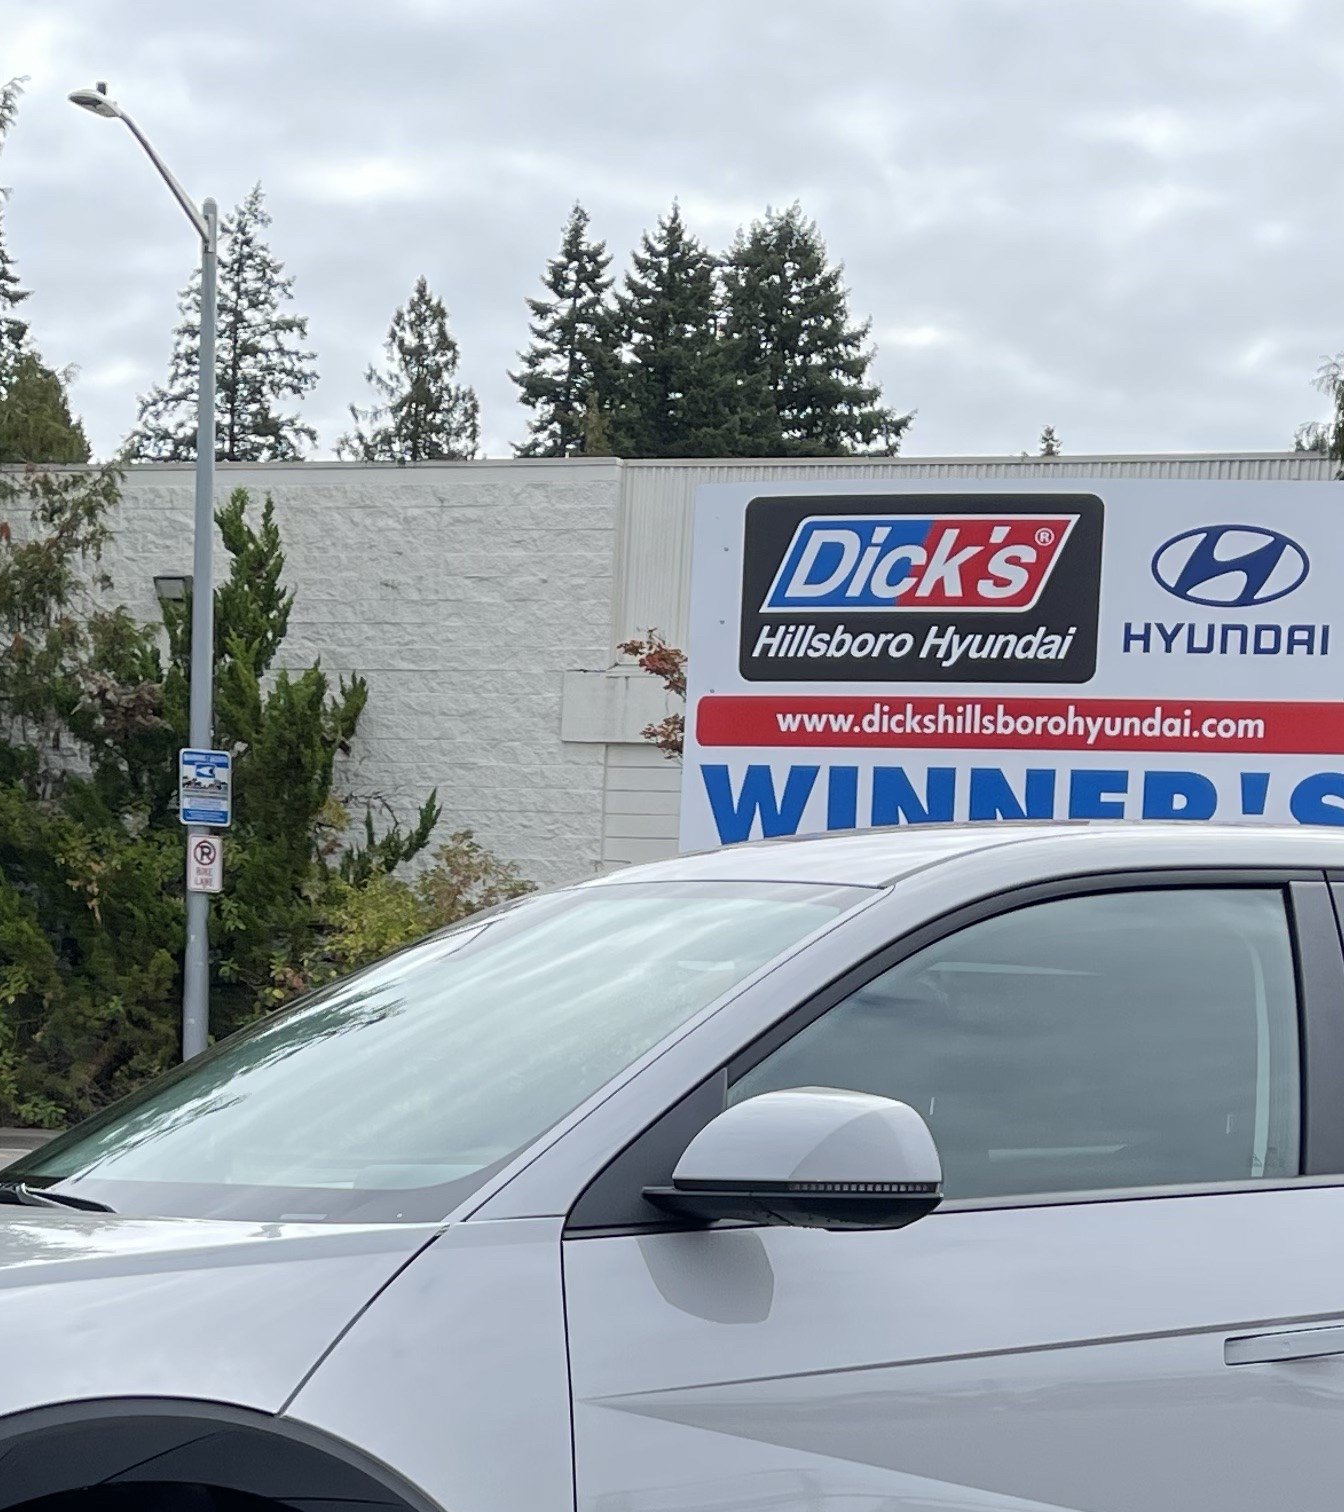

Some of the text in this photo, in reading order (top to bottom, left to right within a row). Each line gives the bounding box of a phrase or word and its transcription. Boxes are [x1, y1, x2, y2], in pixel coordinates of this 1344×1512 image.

[752, 624, 1077, 667] Hillsboro Hyundai
[1123, 622, 1329, 656] HYUNDAI
[776, 703, 1265, 744] www.dickshillsborohyundai.com
